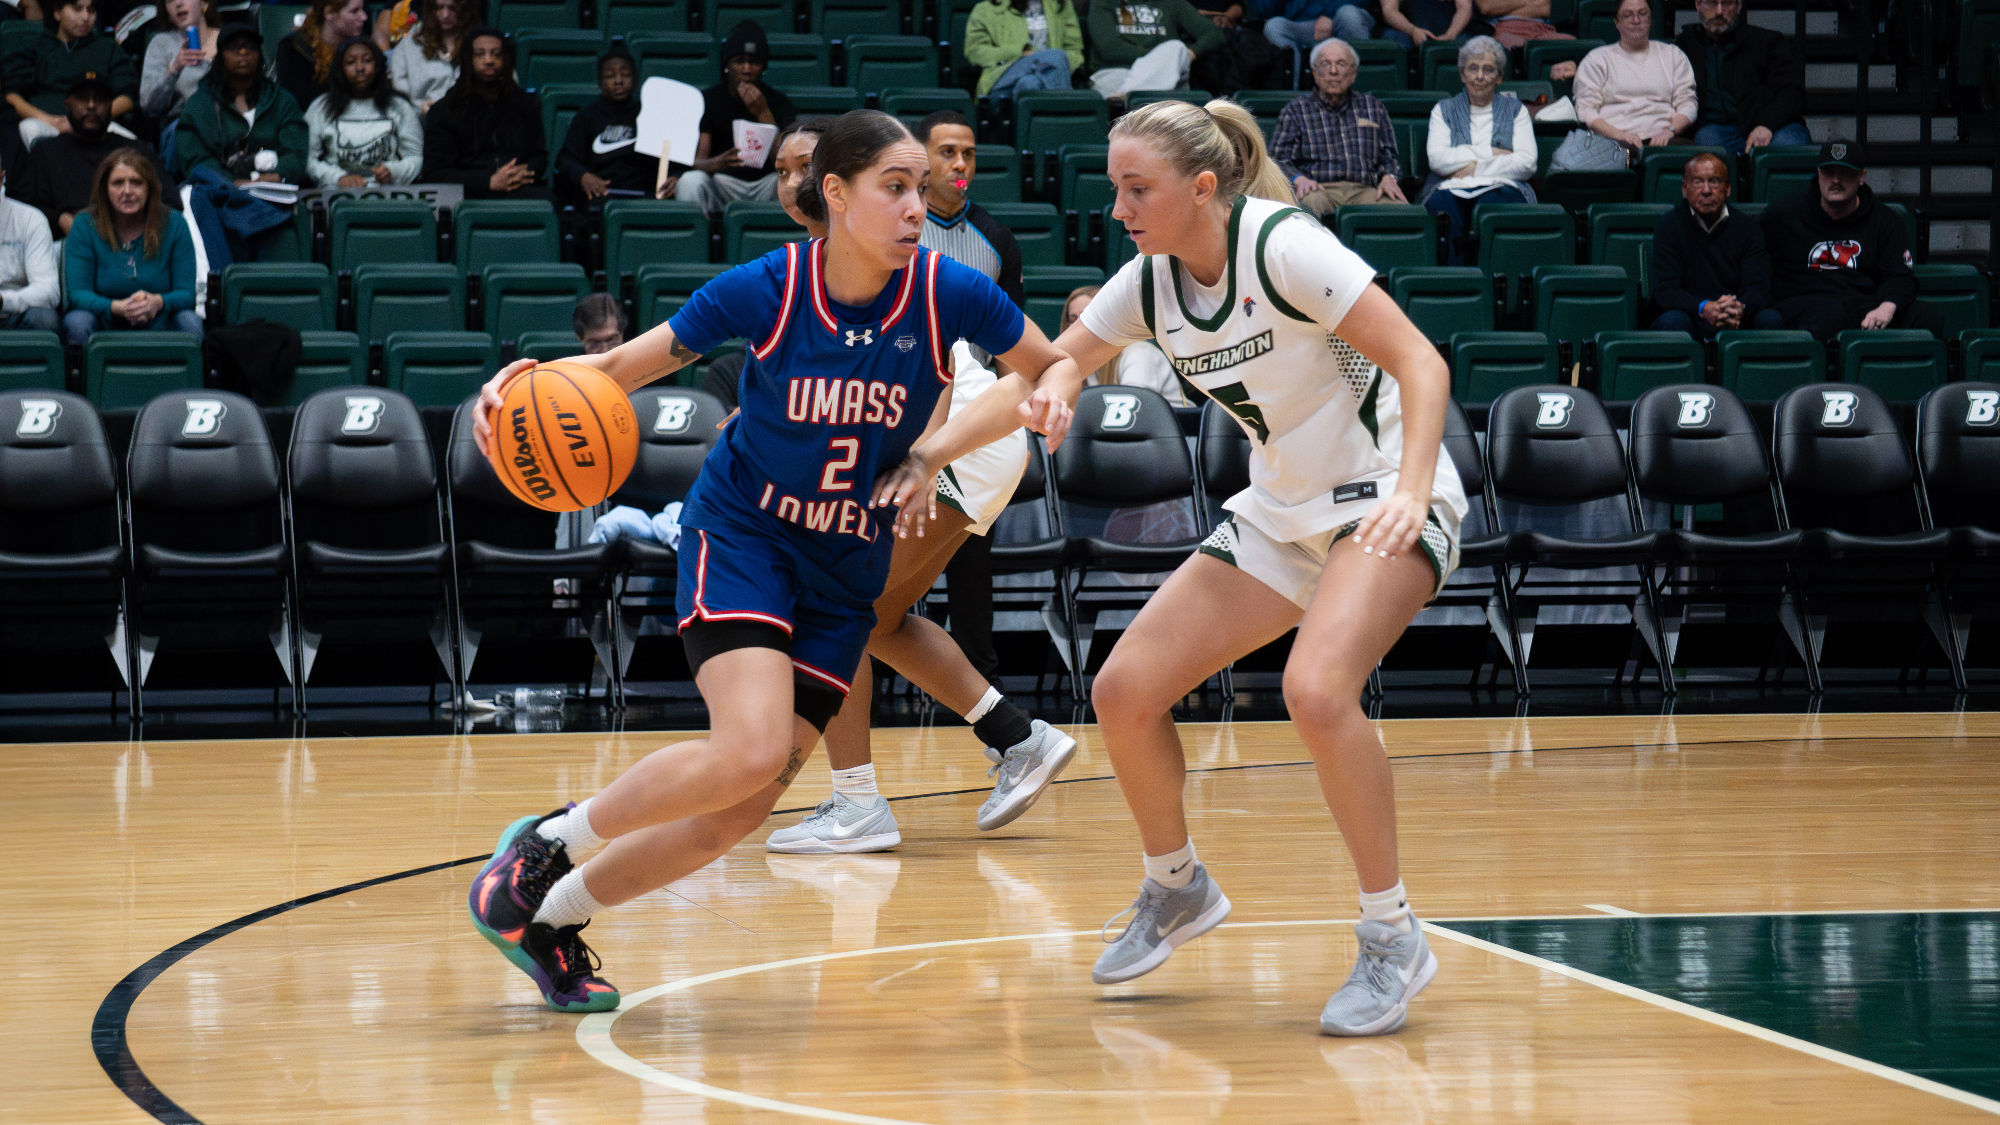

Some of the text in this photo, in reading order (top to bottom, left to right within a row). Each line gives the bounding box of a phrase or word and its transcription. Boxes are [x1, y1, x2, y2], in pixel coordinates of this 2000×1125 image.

[1174, 331, 1273, 375] NGHAMTON
[16, 400, 62, 438] B
[182, 399, 227, 438] B
[341, 397, 385, 435] B
[654, 396, 697, 434] B
[787, 376, 907, 429] UMASS
[1101, 394, 1141, 431] B
[1536, 393, 1574, 429] B
[1677, 392, 1715, 428] B
[1821, 391, 1859, 427] B
[1966, 391, 2000, 426] B
[512, 405, 557, 502] Wilson
[556, 412, 596, 468] EVO
[818, 436, 861, 492] 2
[1363, 486, 1372, 494] M
[758, 481, 880, 544] LOWEL
